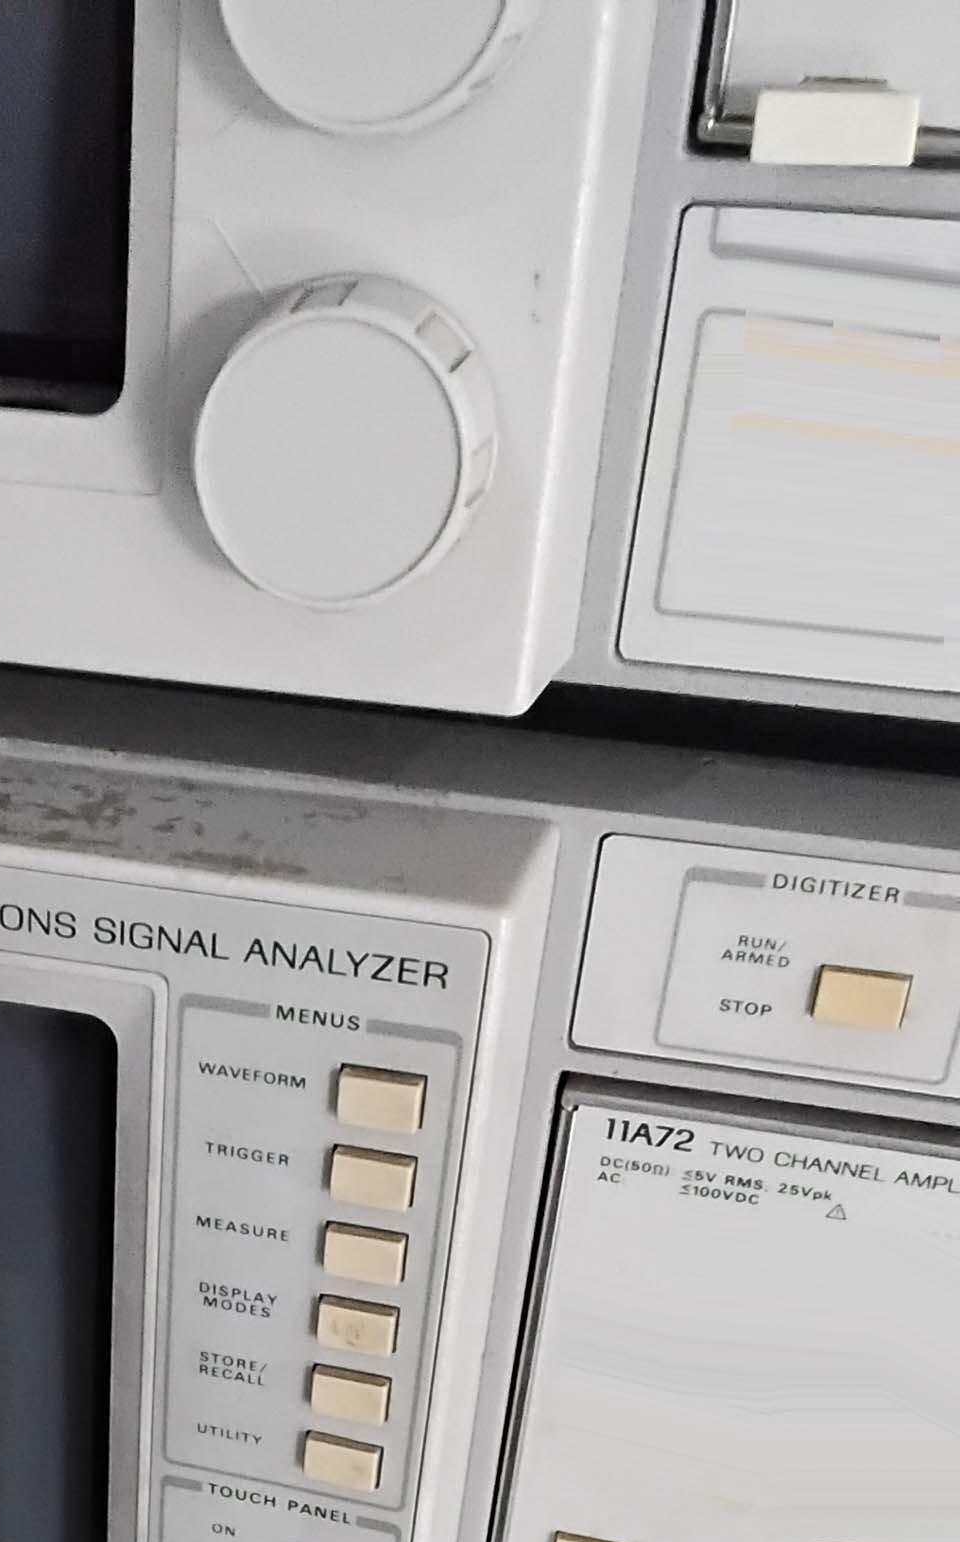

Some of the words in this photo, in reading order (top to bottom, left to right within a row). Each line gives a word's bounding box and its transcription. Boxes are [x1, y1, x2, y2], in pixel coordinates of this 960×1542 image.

[772, 873, 900, 903] DIGITIZER
[94, 916, 229, 961] SIGNAL
[243, 937, 449, 990] ANALYZER
[738, 935, 787, 953] RUN/
[721, 949, 790, 968] ARMED
[276, 1004, 361, 1032] MENUS
[719, 999, 773, 1017] STOP
[199, 1061, 307, 1089] WAVEFORM
[205, 1140, 290, 1167] TRIGGER
[605, 1118, 695, 1152] 11A72
[710, 1141, 764, 1163] TWO
[774, 1151, 887, 1182] CHANNEL
[894, 1171, 960, 1194] AMPL
[597, 1172, 622, 1184] AC
[777, 1183, 833, 1202] 25Vpk
[196, 1215, 290, 1242] MEASURE
[198, 1281, 278, 1306] DISPLAY
[202, 1295, 271, 1319] MODES
[199, 1350, 268, 1373] STORE/
[199, 1364, 265, 1387] RECALL
[196, 1423, 263, 1445] UTILITY
[208, 1481, 277, 1508] TOUCH
[287, 1500, 352, 1525] PANEL
[211, 1523, 237, 1538] ON
